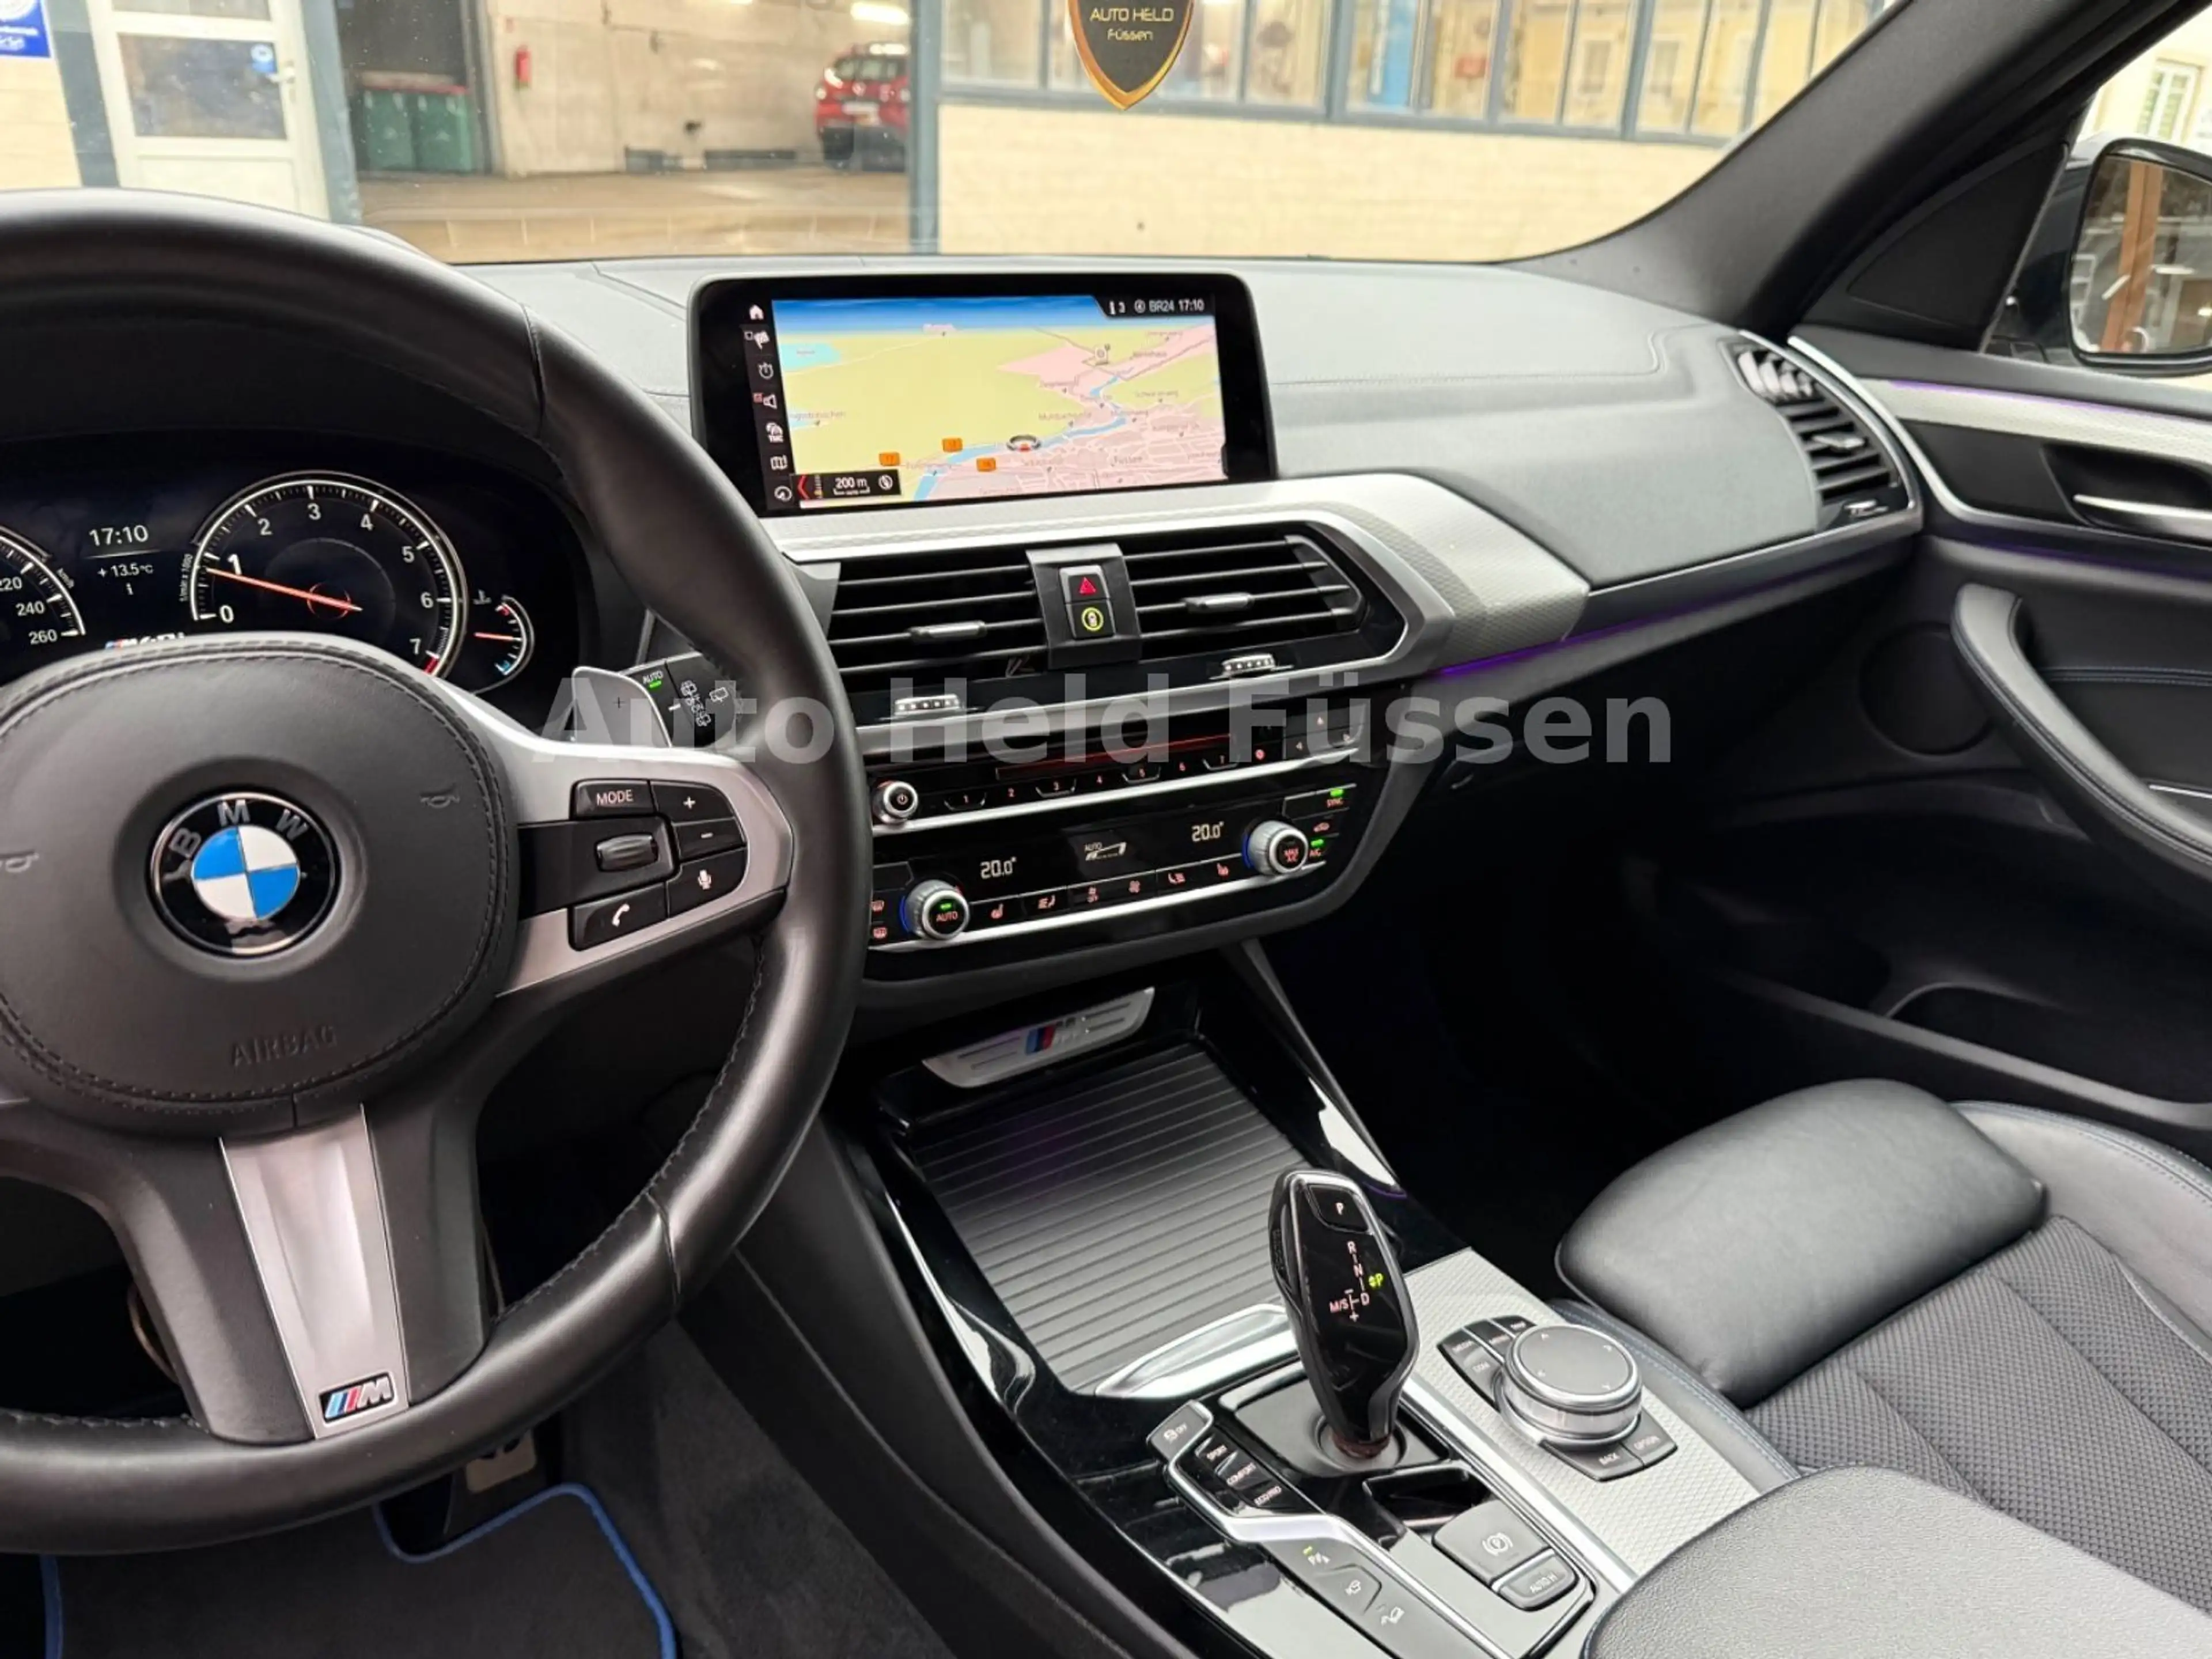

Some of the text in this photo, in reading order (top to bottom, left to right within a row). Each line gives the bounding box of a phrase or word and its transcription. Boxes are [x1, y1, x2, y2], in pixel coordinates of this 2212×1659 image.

[1089, 8, 1128, 22] AUTO
[1149, 300, 1175, 312] BR24
[1179, 298, 1205, 312] 17:10
[835, 477, 867, 488] 200 m
[309, 503, 321, 520] 3
[258, 519, 272, 536] 2
[360, 513, 373, 531] 4
[89, 525, 148, 547] 17:10
[402, 546, 415, 562] 5
[228, 554, 241, 575] 1
[421, 593, 434, 608] 6
[16, 601, 45, 616] 240
[219, 605, 234, 623] 0
[29, 628, 57, 645] 260
[410, 638, 421, 654] 7
[642, 671, 664, 684] AUTO
[596, 789, 633, 805] MODE
[1007, 788, 1014, 797] 2
[171, 799, 308, 858] BMW
[936, 911, 958, 922] AUTO
[231, 1024, 338, 1067] AIRBAG
[1335, 1202, 1344, 1215] P
[1347, 1241, 1357, 1255] R
[1354, 1264, 1364, 1278] N
[1360, 1292, 1370, 1306] D
